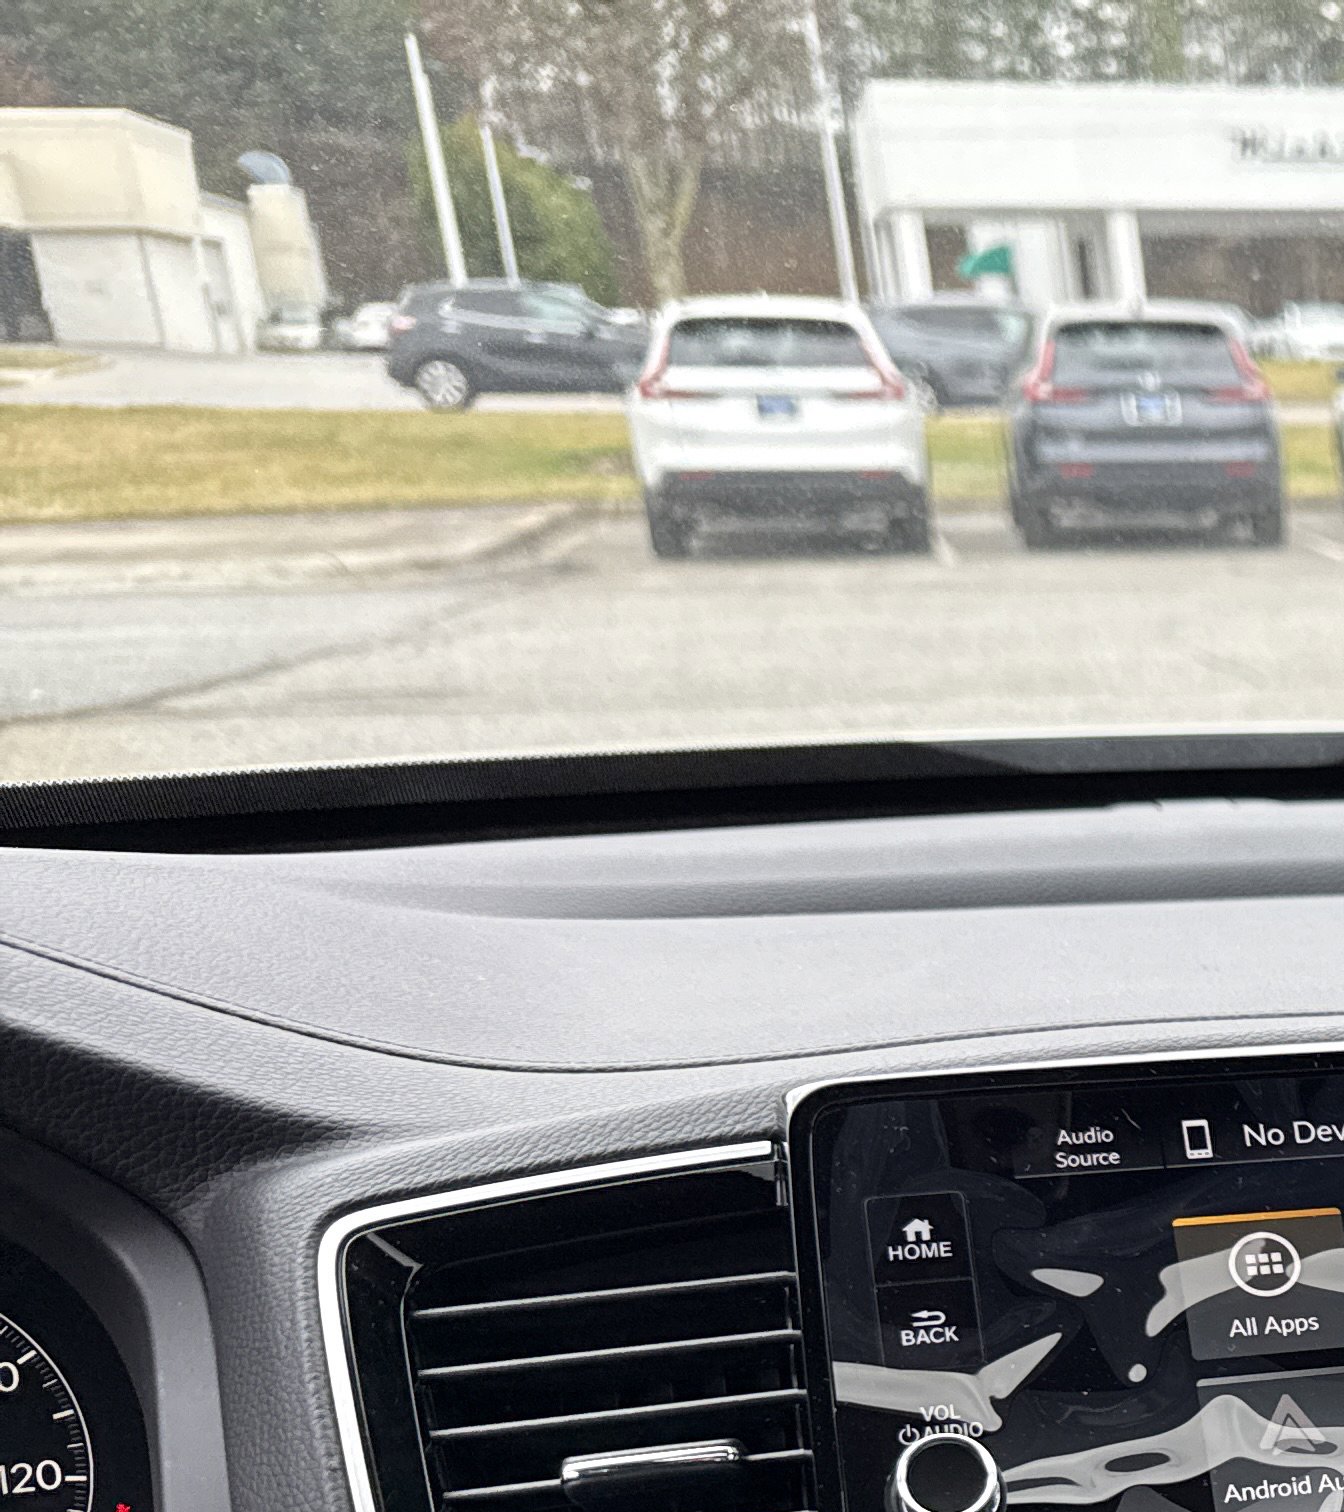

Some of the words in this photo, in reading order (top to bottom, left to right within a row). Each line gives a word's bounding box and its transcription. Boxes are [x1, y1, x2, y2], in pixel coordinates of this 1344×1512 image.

[1057, 1126, 1114, 1147] Audio
[1243, 1123, 1285, 1149] No
[1055, 1148, 1121, 1169] Source
[887, 1240, 953, 1262] HOME
[900, 1324, 959, 1347] BACK
[1229, 1315, 1259, 1338] All
[1263, 1313, 1320, 1339] Apps
[920, 1403, 961, 1422] VOL
[1224, 1475, 1313, 1504] Android
